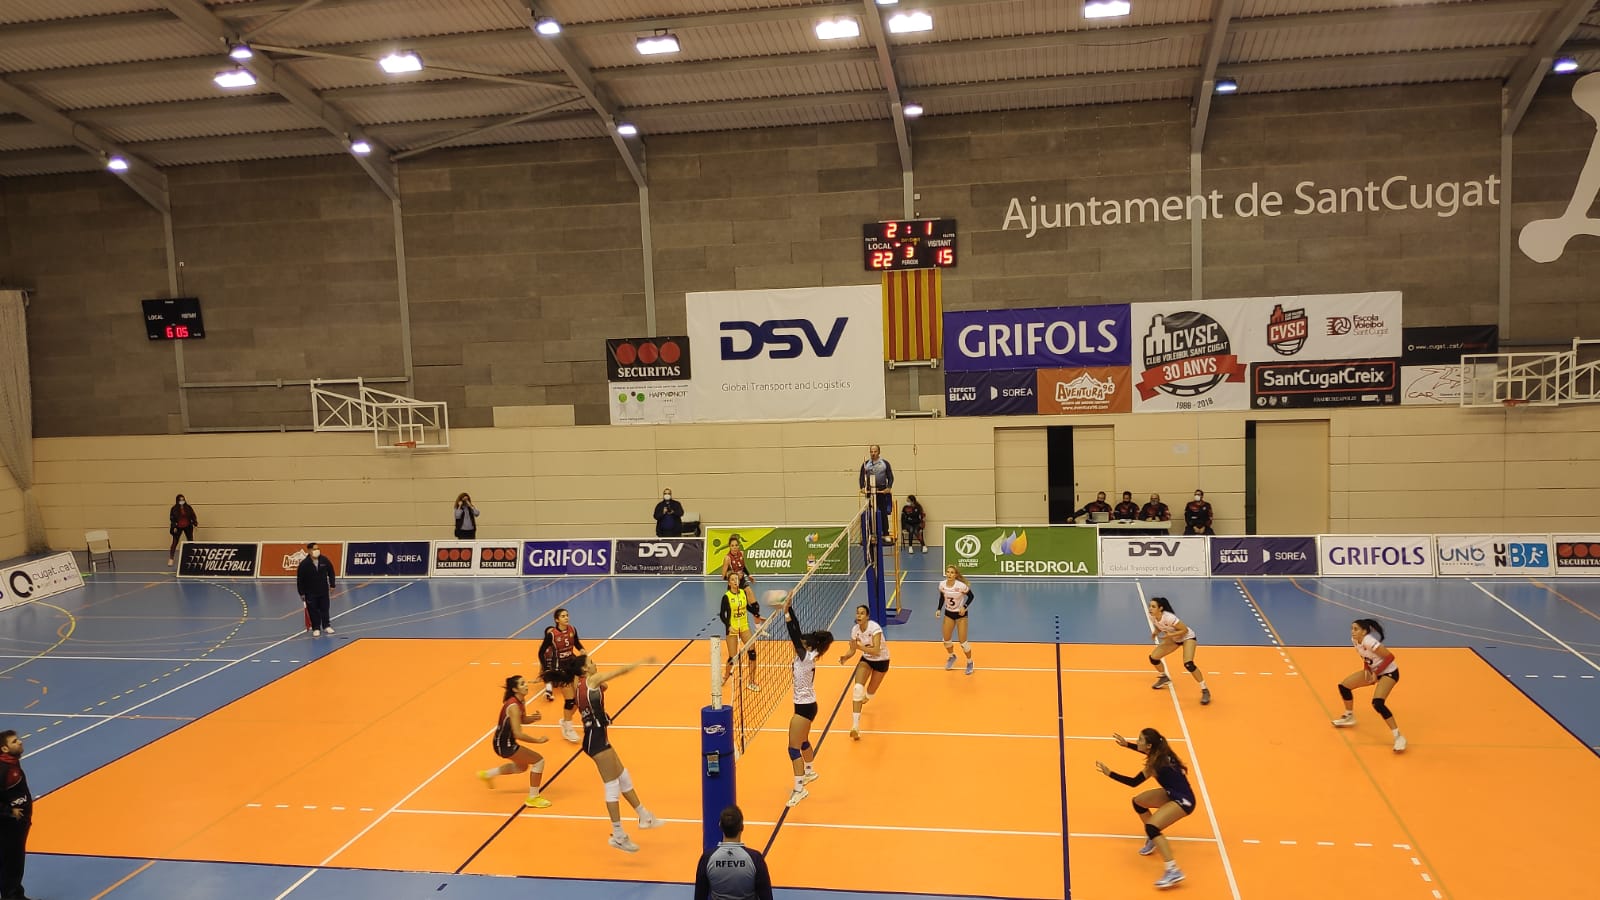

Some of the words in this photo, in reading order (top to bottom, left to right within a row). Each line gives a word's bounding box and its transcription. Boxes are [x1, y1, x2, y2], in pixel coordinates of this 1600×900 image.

[1002, 187, 1223, 238] Ajuntament
[1235, 182, 1283, 217] de
[1294, 173, 1501, 219] SantCugat
[887, 223, 897, 238] 2
[927, 221, 932, 235] 1
[872, 252, 893, 267] 22
[906, 247, 914, 258] 3
[938, 249, 953, 264] 15
[1353, 314, 1379, 322] Escola
[1270, 320, 1305, 341] CVSC
[720, 317, 849, 361] DSV
[958, 319, 1118, 358] GRIFOLS
[1173, 323, 1218, 351] CVSC
[1190, 346, 1206, 356] SANT
[617, 366, 681, 378] SECURITAS
[1163, 363, 1180, 380] 30
[1184, 358, 1217, 377] ANYS
[1264, 368, 1384, 388] SantCugatCreix
[721, 382, 749, 392] Global
[751, 381, 792, 393] Transport
[794, 380, 811, 390] and
[812, 380, 851, 392] Logistics
[1002, 388, 1033, 397] SOREA
[949, 392, 976, 401] BLAU
[1408, 391, 1434, 399] CAR
[774, 539, 792, 548] LIGA
[1128, 542, 1180, 556] DSV
[208, 549, 238, 559] GEFF
[639, 543, 684, 558] DSV
[747, 549, 792, 559] IBERDROLA
[1275, 552, 1306, 561] SOREA
[1329, 546, 1425, 565] GRIFOLS
[529, 549, 607, 567] GRIFOLS
[755, 560, 791, 568] VOLEIBOL
[1220, 555, 1248, 563] BLAU
[32, 562, 75, 580] cugat.cat
[204, 560, 252, 571] VOLLEYBALL
[1001, 561, 1088, 573] IBERDROLA
[947, 597, 955, 606] 3
